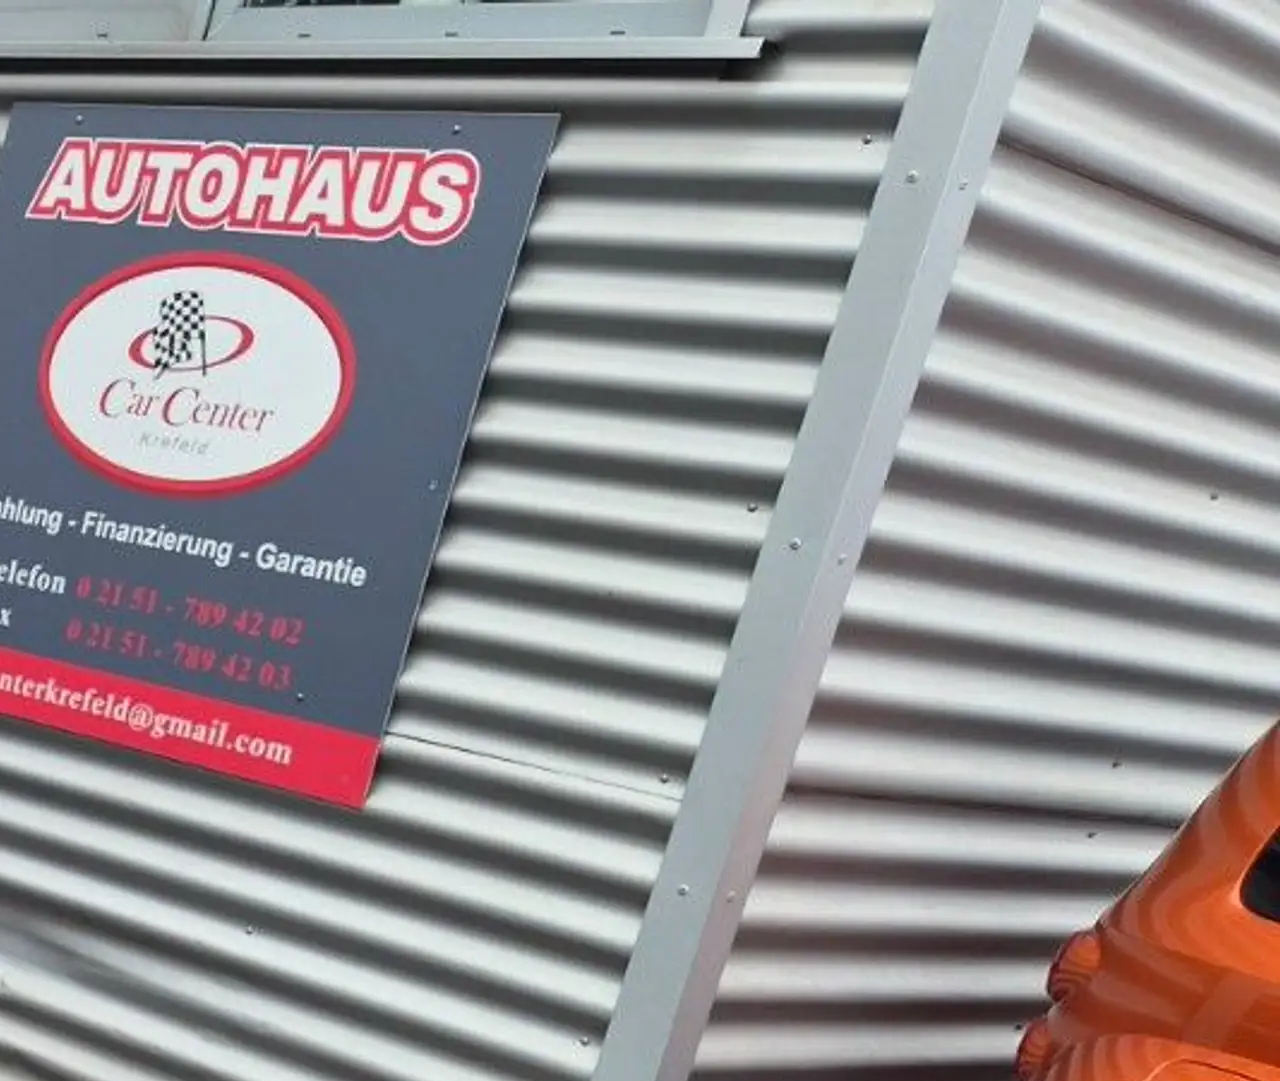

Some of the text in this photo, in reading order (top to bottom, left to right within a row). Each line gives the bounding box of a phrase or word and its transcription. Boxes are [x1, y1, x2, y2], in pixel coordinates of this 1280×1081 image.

[25, 138, 480, 246] AUTOHAUS
[80, 510, 234, 568] Finanzierung
[255, 542, 368, 588] Garantie
[97, 579, 124, 608] 21
[131, 587, 159, 613] 51
[184, 596, 228, 628] 789
[269, 616, 304, 645] 02
[172, 640, 216, 672] 789
